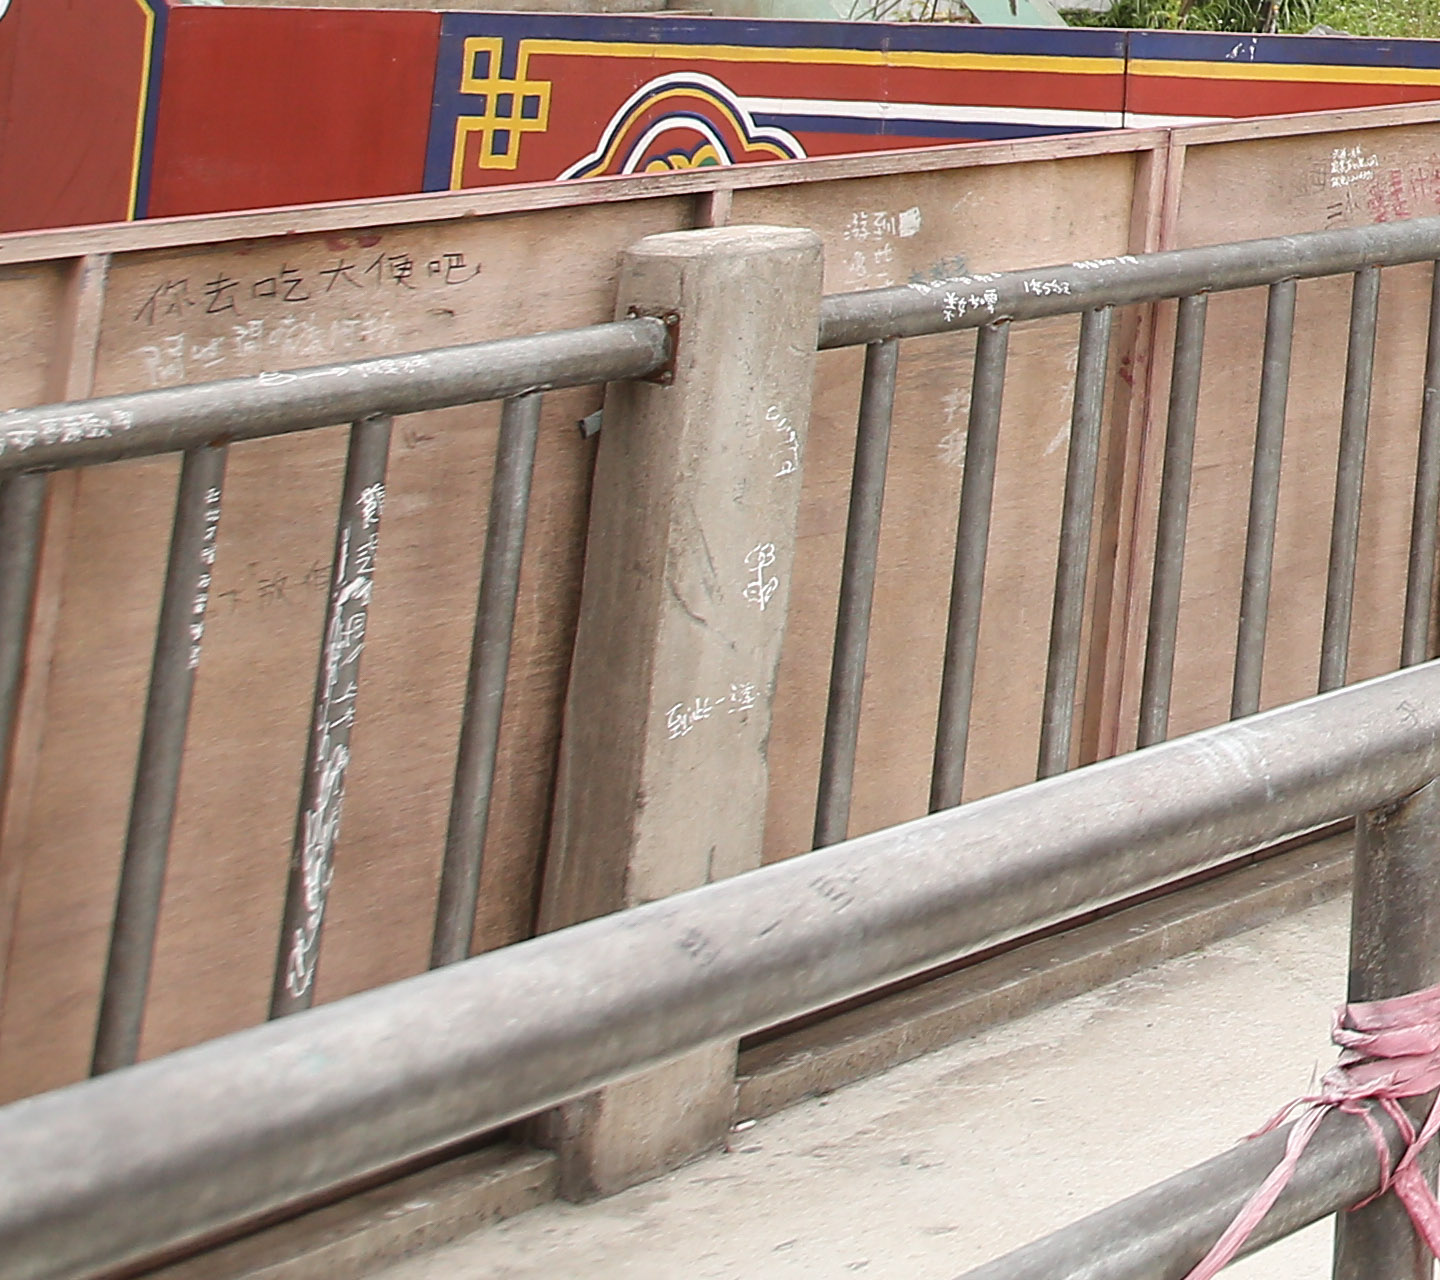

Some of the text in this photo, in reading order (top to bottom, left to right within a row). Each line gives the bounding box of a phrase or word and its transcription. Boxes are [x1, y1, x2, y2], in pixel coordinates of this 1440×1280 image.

[134, 252, 483, 326] 你去吃大便吧
